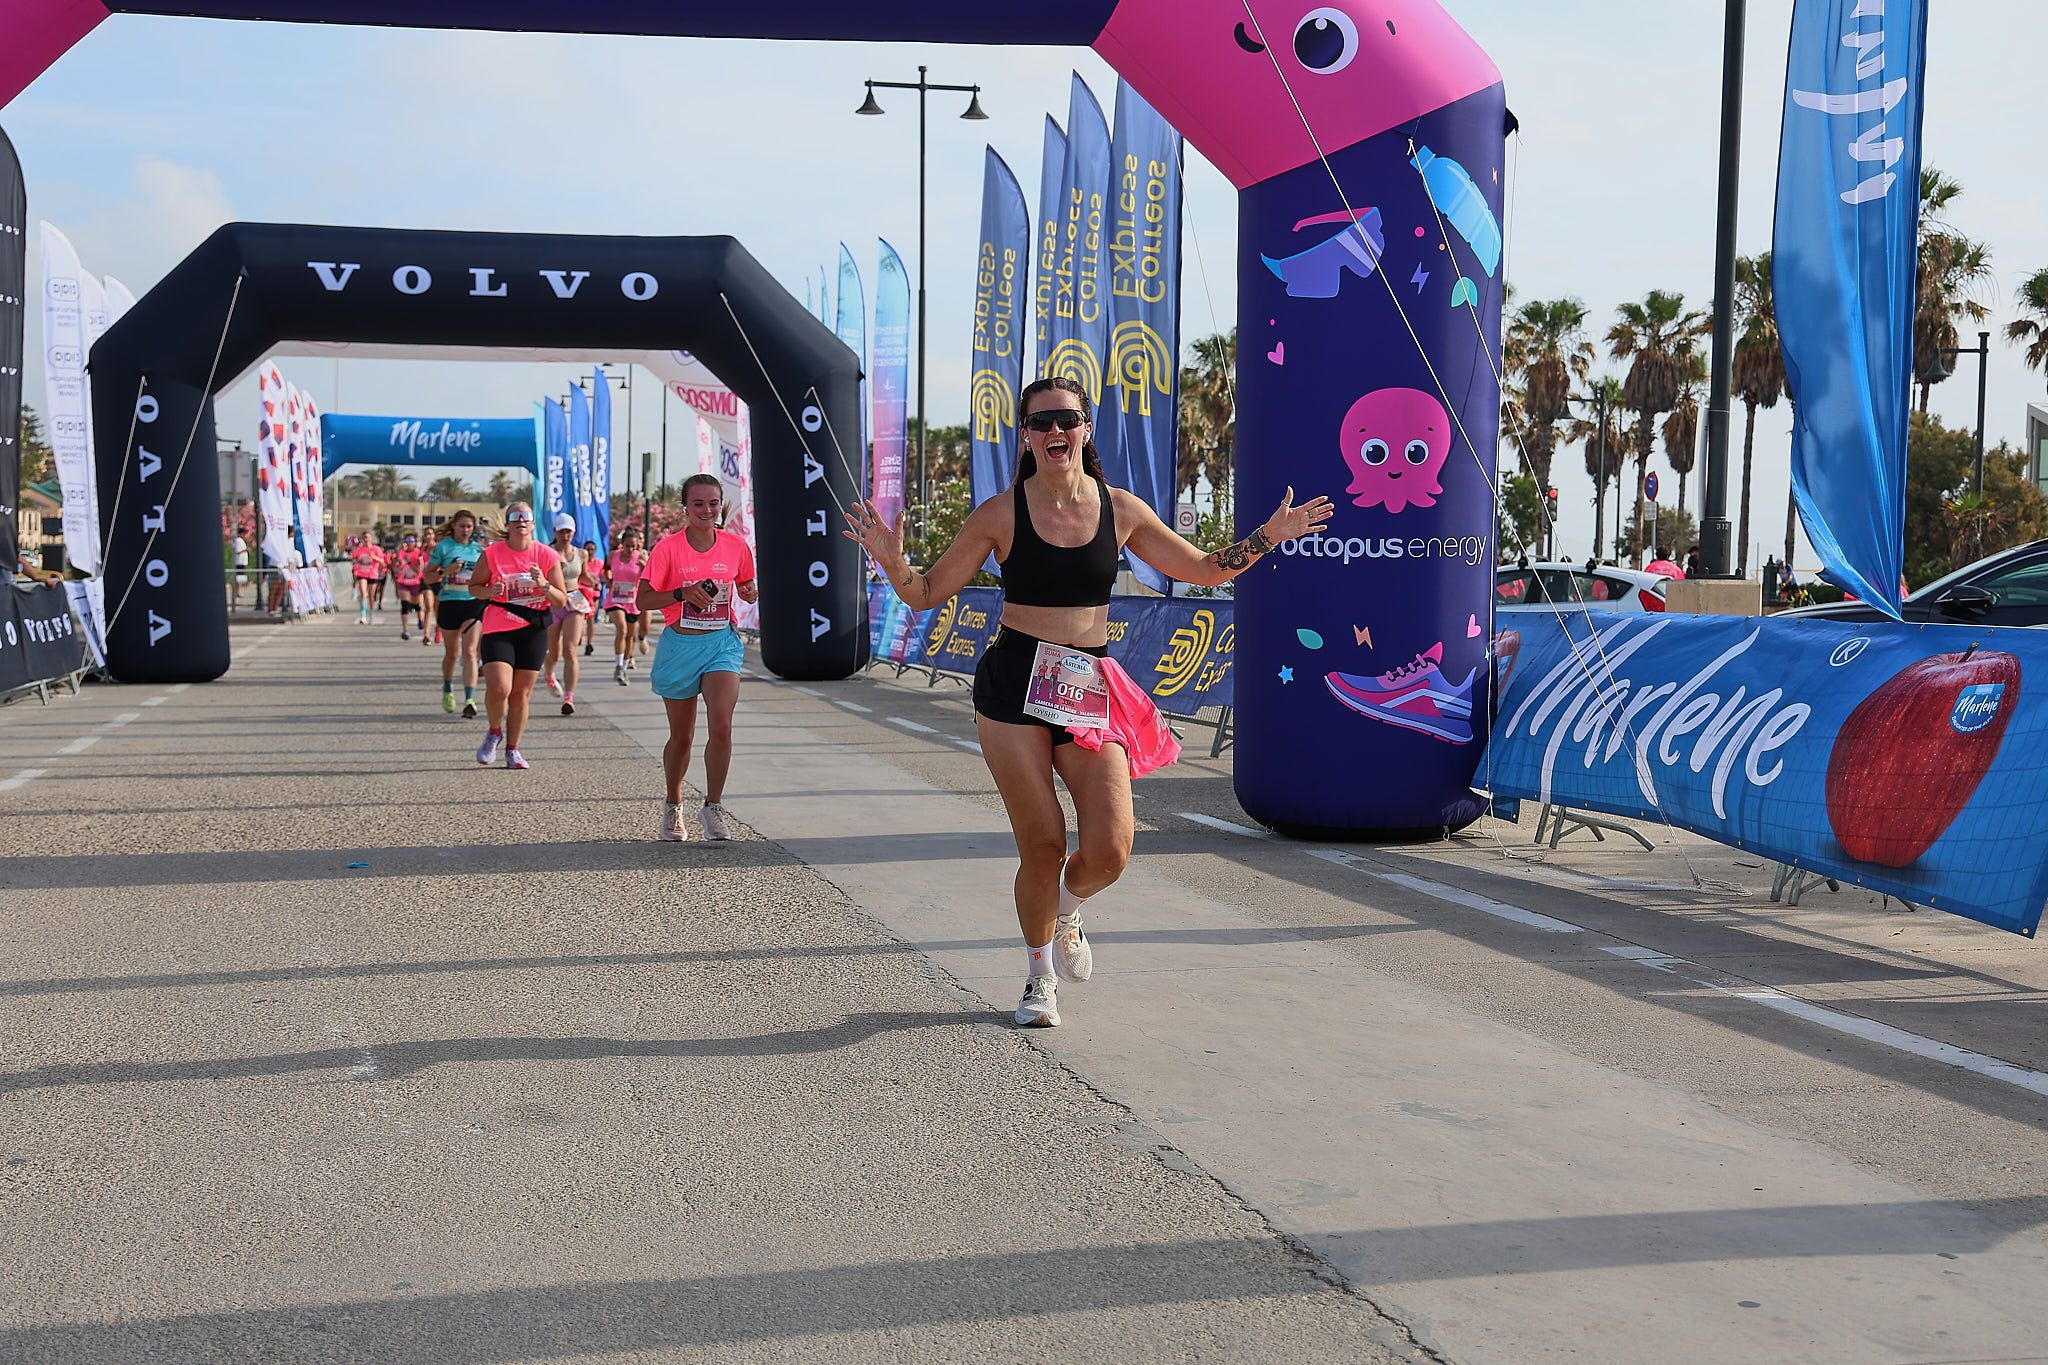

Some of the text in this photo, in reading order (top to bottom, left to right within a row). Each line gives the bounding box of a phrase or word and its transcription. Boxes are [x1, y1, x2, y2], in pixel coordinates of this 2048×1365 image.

[307, 262, 659, 300] VOLVO
[677, 386, 738, 417] COSMO
[389, 420, 481, 459] Marlene
[137, 395, 172, 647] VOLVO
[801, 405, 831, 643] VOLVO
[1281, 533, 1487, 566] octopus energy
[958, 604, 987, 629] Correos
[1057, 683, 1085, 701] 016
[1955, 695, 1998, 721] Marlene
[1033, 707, 1060, 719] OYSHO
[1505, 617, 1811, 820] Marlene
